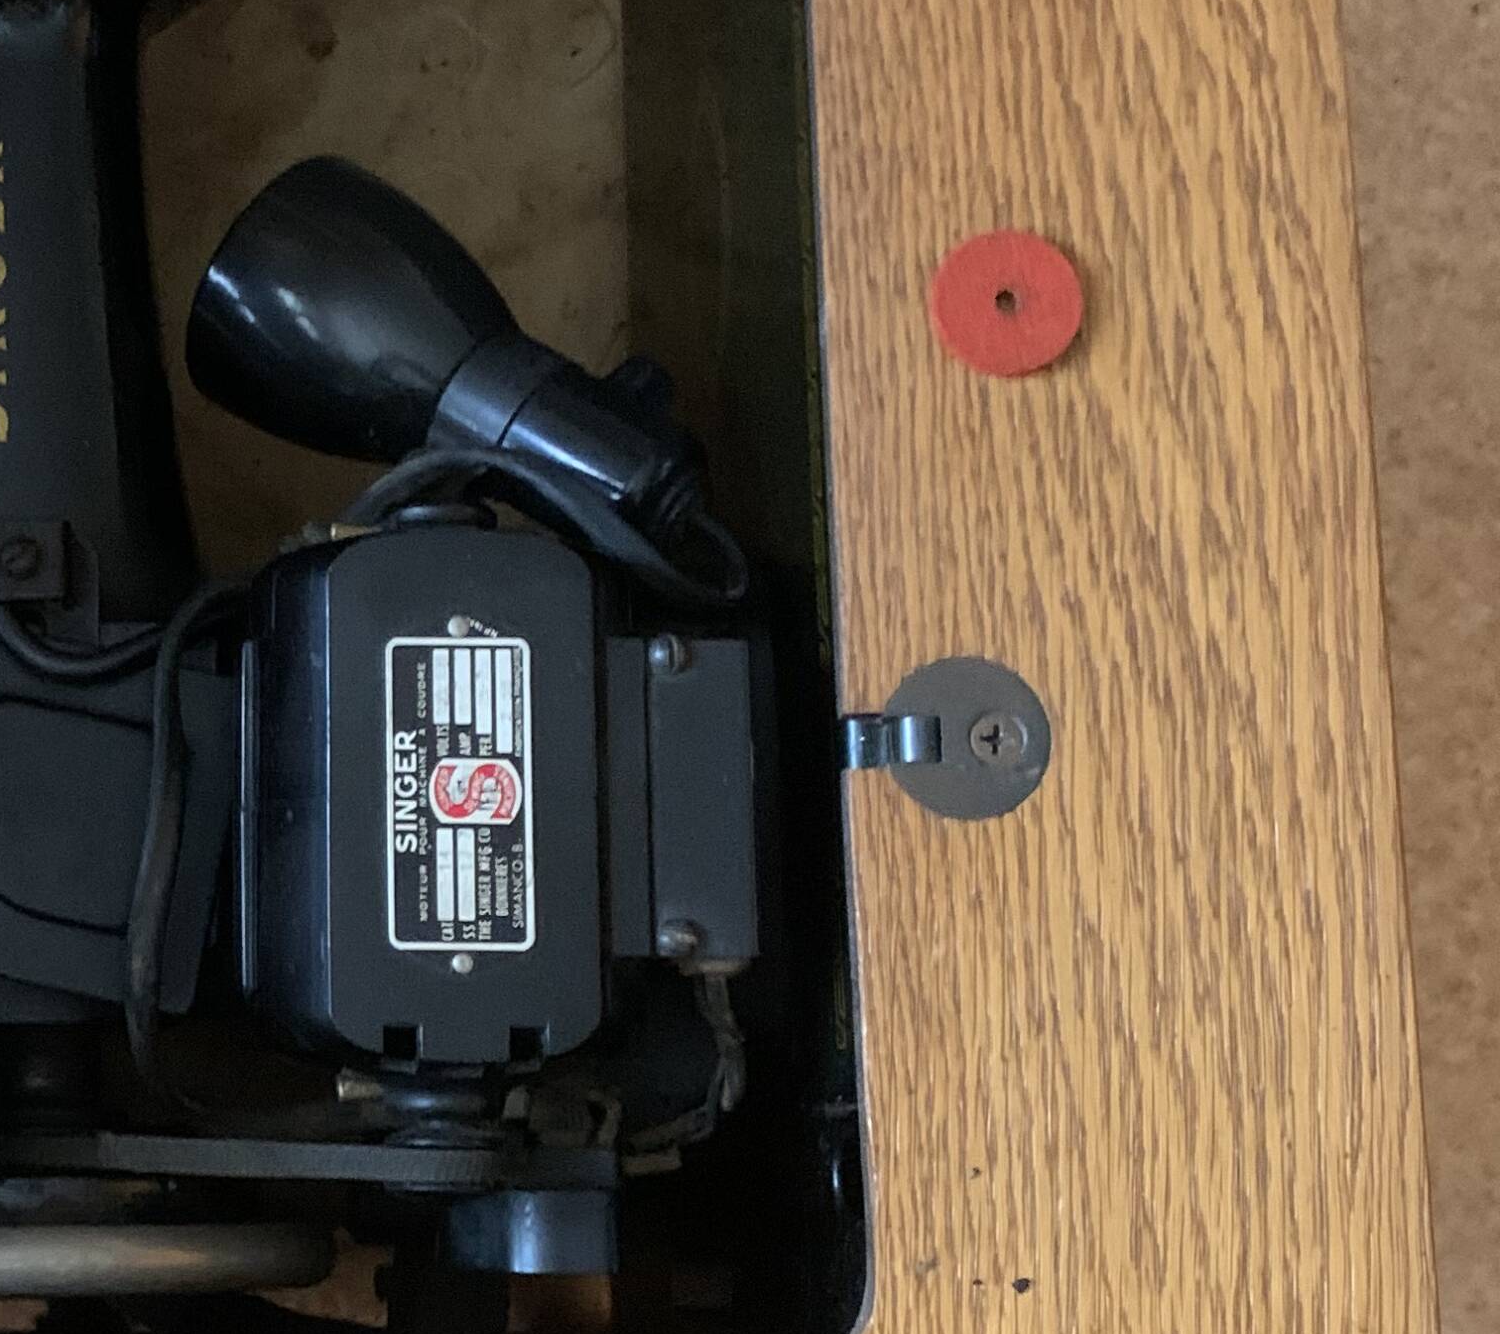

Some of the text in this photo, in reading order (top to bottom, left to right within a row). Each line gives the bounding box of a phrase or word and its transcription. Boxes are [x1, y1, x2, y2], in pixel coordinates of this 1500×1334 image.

[417, 662, 427, 718] COUDRE
[394, 730, 418, 853] SINGER
[418, 746, 427, 807] MACHINE
[419, 817, 428, 855] POUR
[419, 865, 429, 922] MOTEUR
[478, 875, 492, 916] SINGER
[440, 921, 455, 941] CAT
[479, 920, 492, 940] THE
